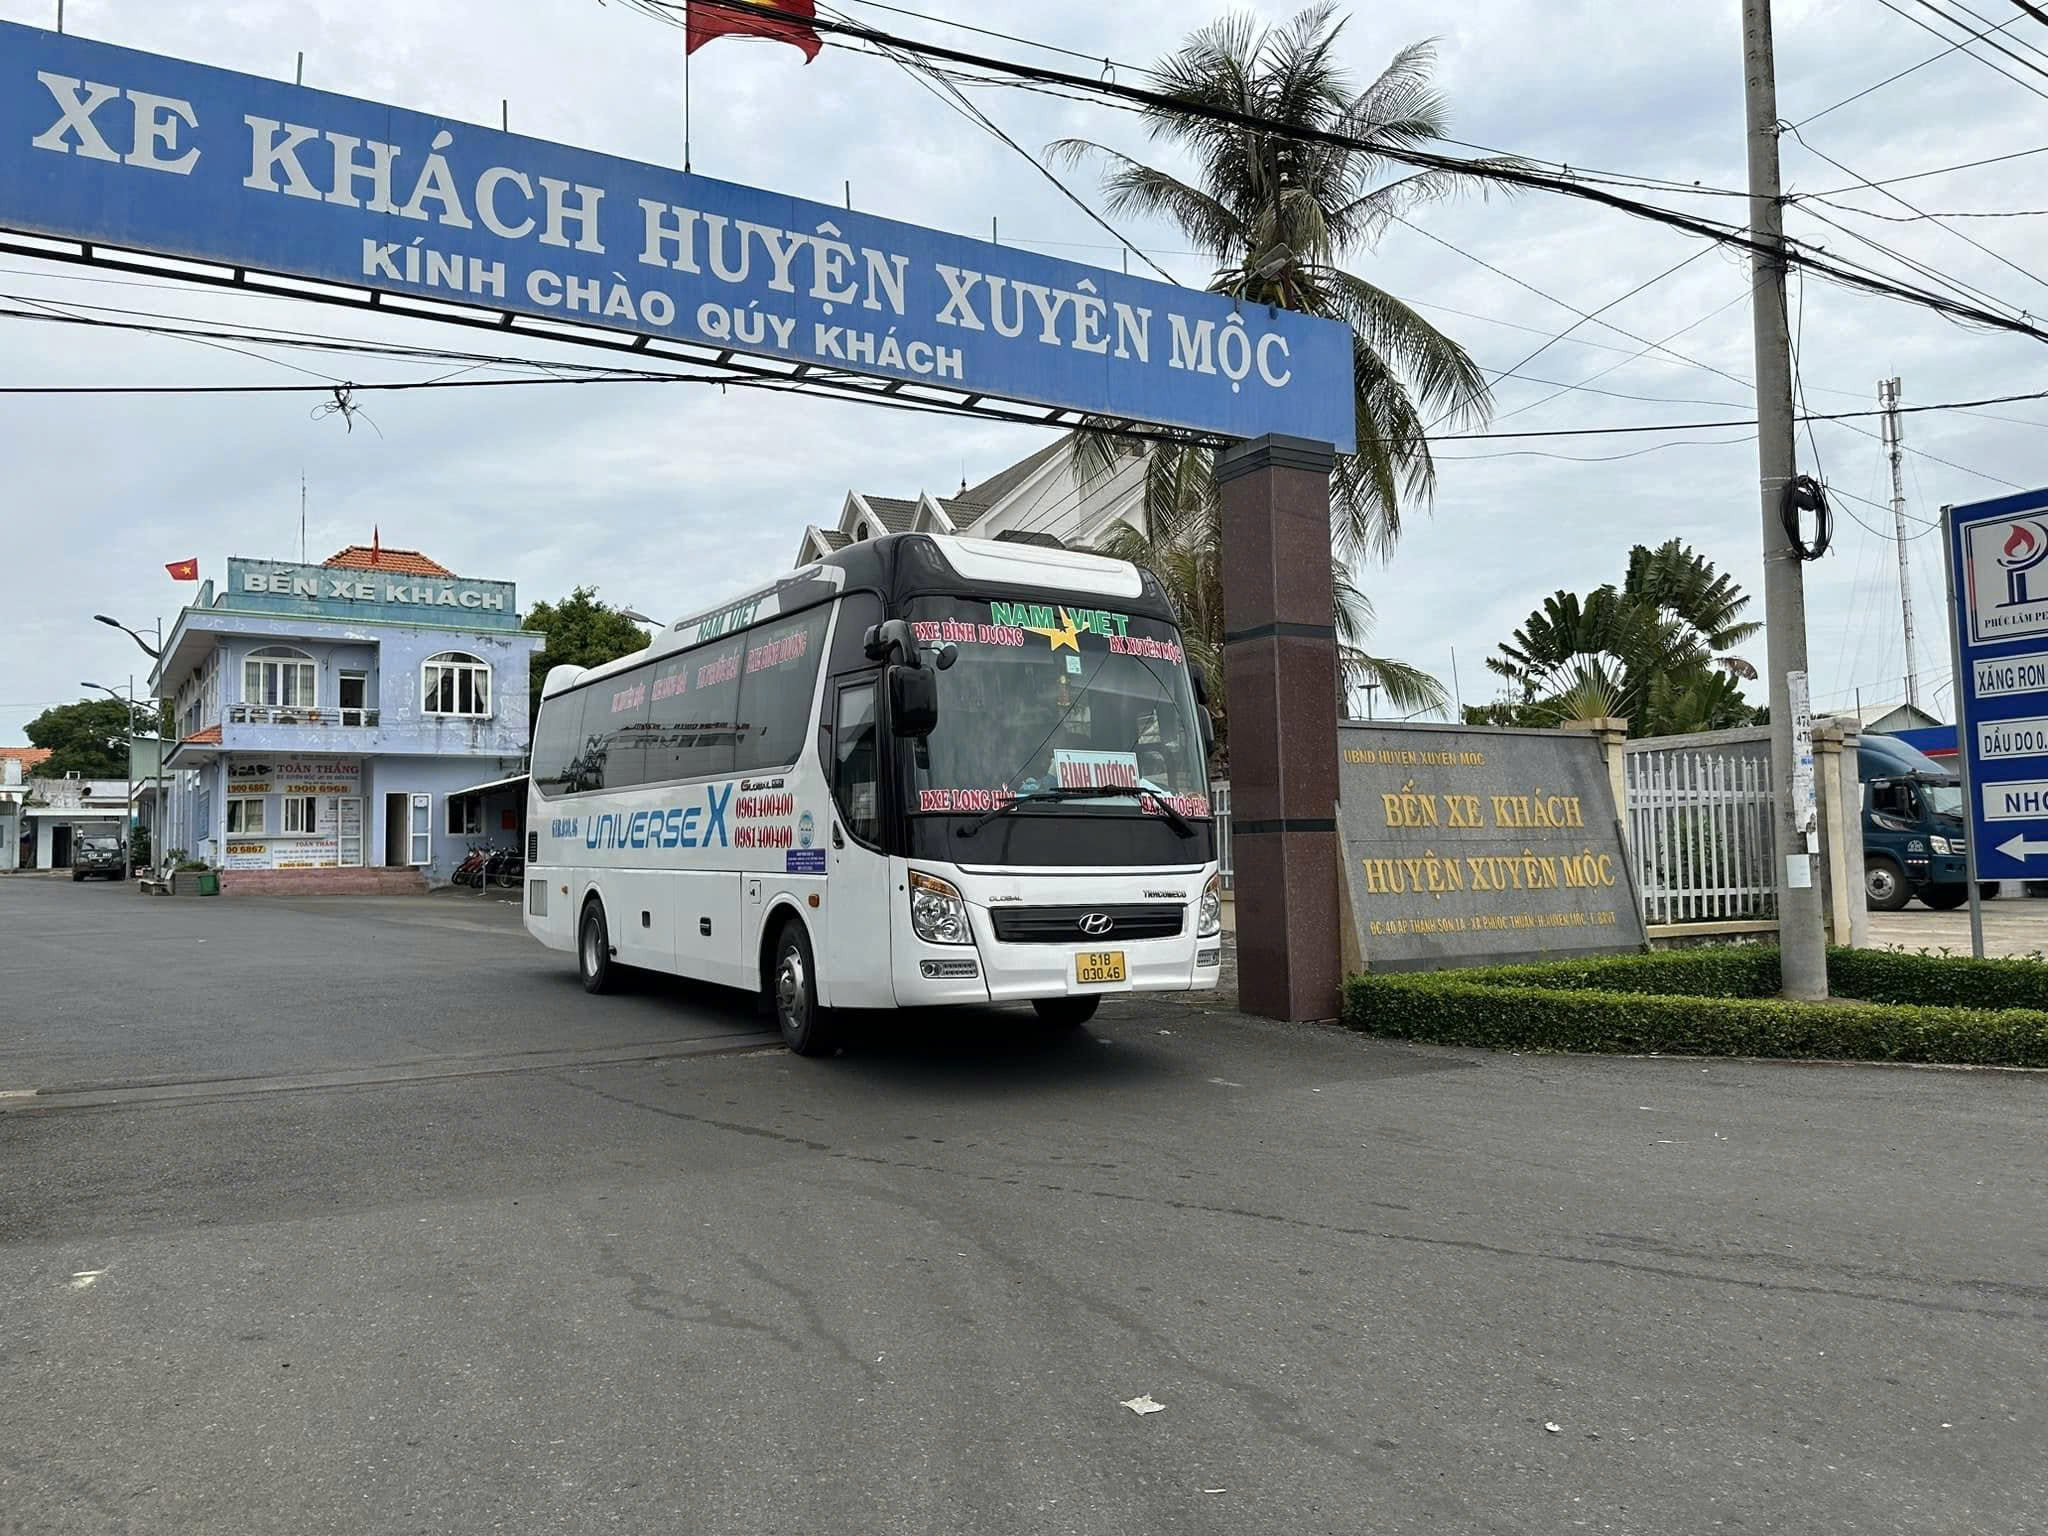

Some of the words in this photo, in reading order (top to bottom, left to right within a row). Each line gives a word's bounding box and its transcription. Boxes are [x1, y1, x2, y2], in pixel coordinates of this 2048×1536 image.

[32, 70, 202, 177] XE
[243, 113, 606, 256] KHÁCH
[638, 197, 910, 316] HUYỆN
[935, 263, 1152, 363] XUYÊN
[1169, 311, 1292, 394] MỘC
[363, 236, 505, 297] KÍNH
[526, 269, 674, 327] CHÀO
[815, 323, 964, 380] KHÁCH
[243, 568, 318, 597] BẾN
[329, 580, 376, 601] XE
[385, 584, 504, 611] KHÁCH
[911, 621, 942, 642] BXE
[941, 616, 977, 643] BÌNH
[990, 601, 1056, 631] NAM
[1067, 606, 1128, 638] VIỆT
[1978, 664, 2015, 692] XĂNG
[2018, 663, 2046, 687] RON
[1984, 726, 2011, 753] DẦU
[2015, 731, 2033, 752] DO
[1060, 753, 1092, 789] BÌNH
[1343, 749, 1376, 764] UBND
[735, 792, 793, 819] 0961400400
[919, 788, 951, 811] BXE
[951, 788, 991, 811] LONG
[1382, 778, 1440, 828] BẾN
[1443, 794, 1484, 828] XE
[1489, 787, 1585, 829] KHÁCH
[734, 824, 793, 849] 0981400400
[1362, 848, 1465, 900] HUYỆN
[1466, 847, 1558, 891] XUYÊN
[1560, 847, 1616, 895] MỘC
[1082, 967, 1120, 981] 030.46
